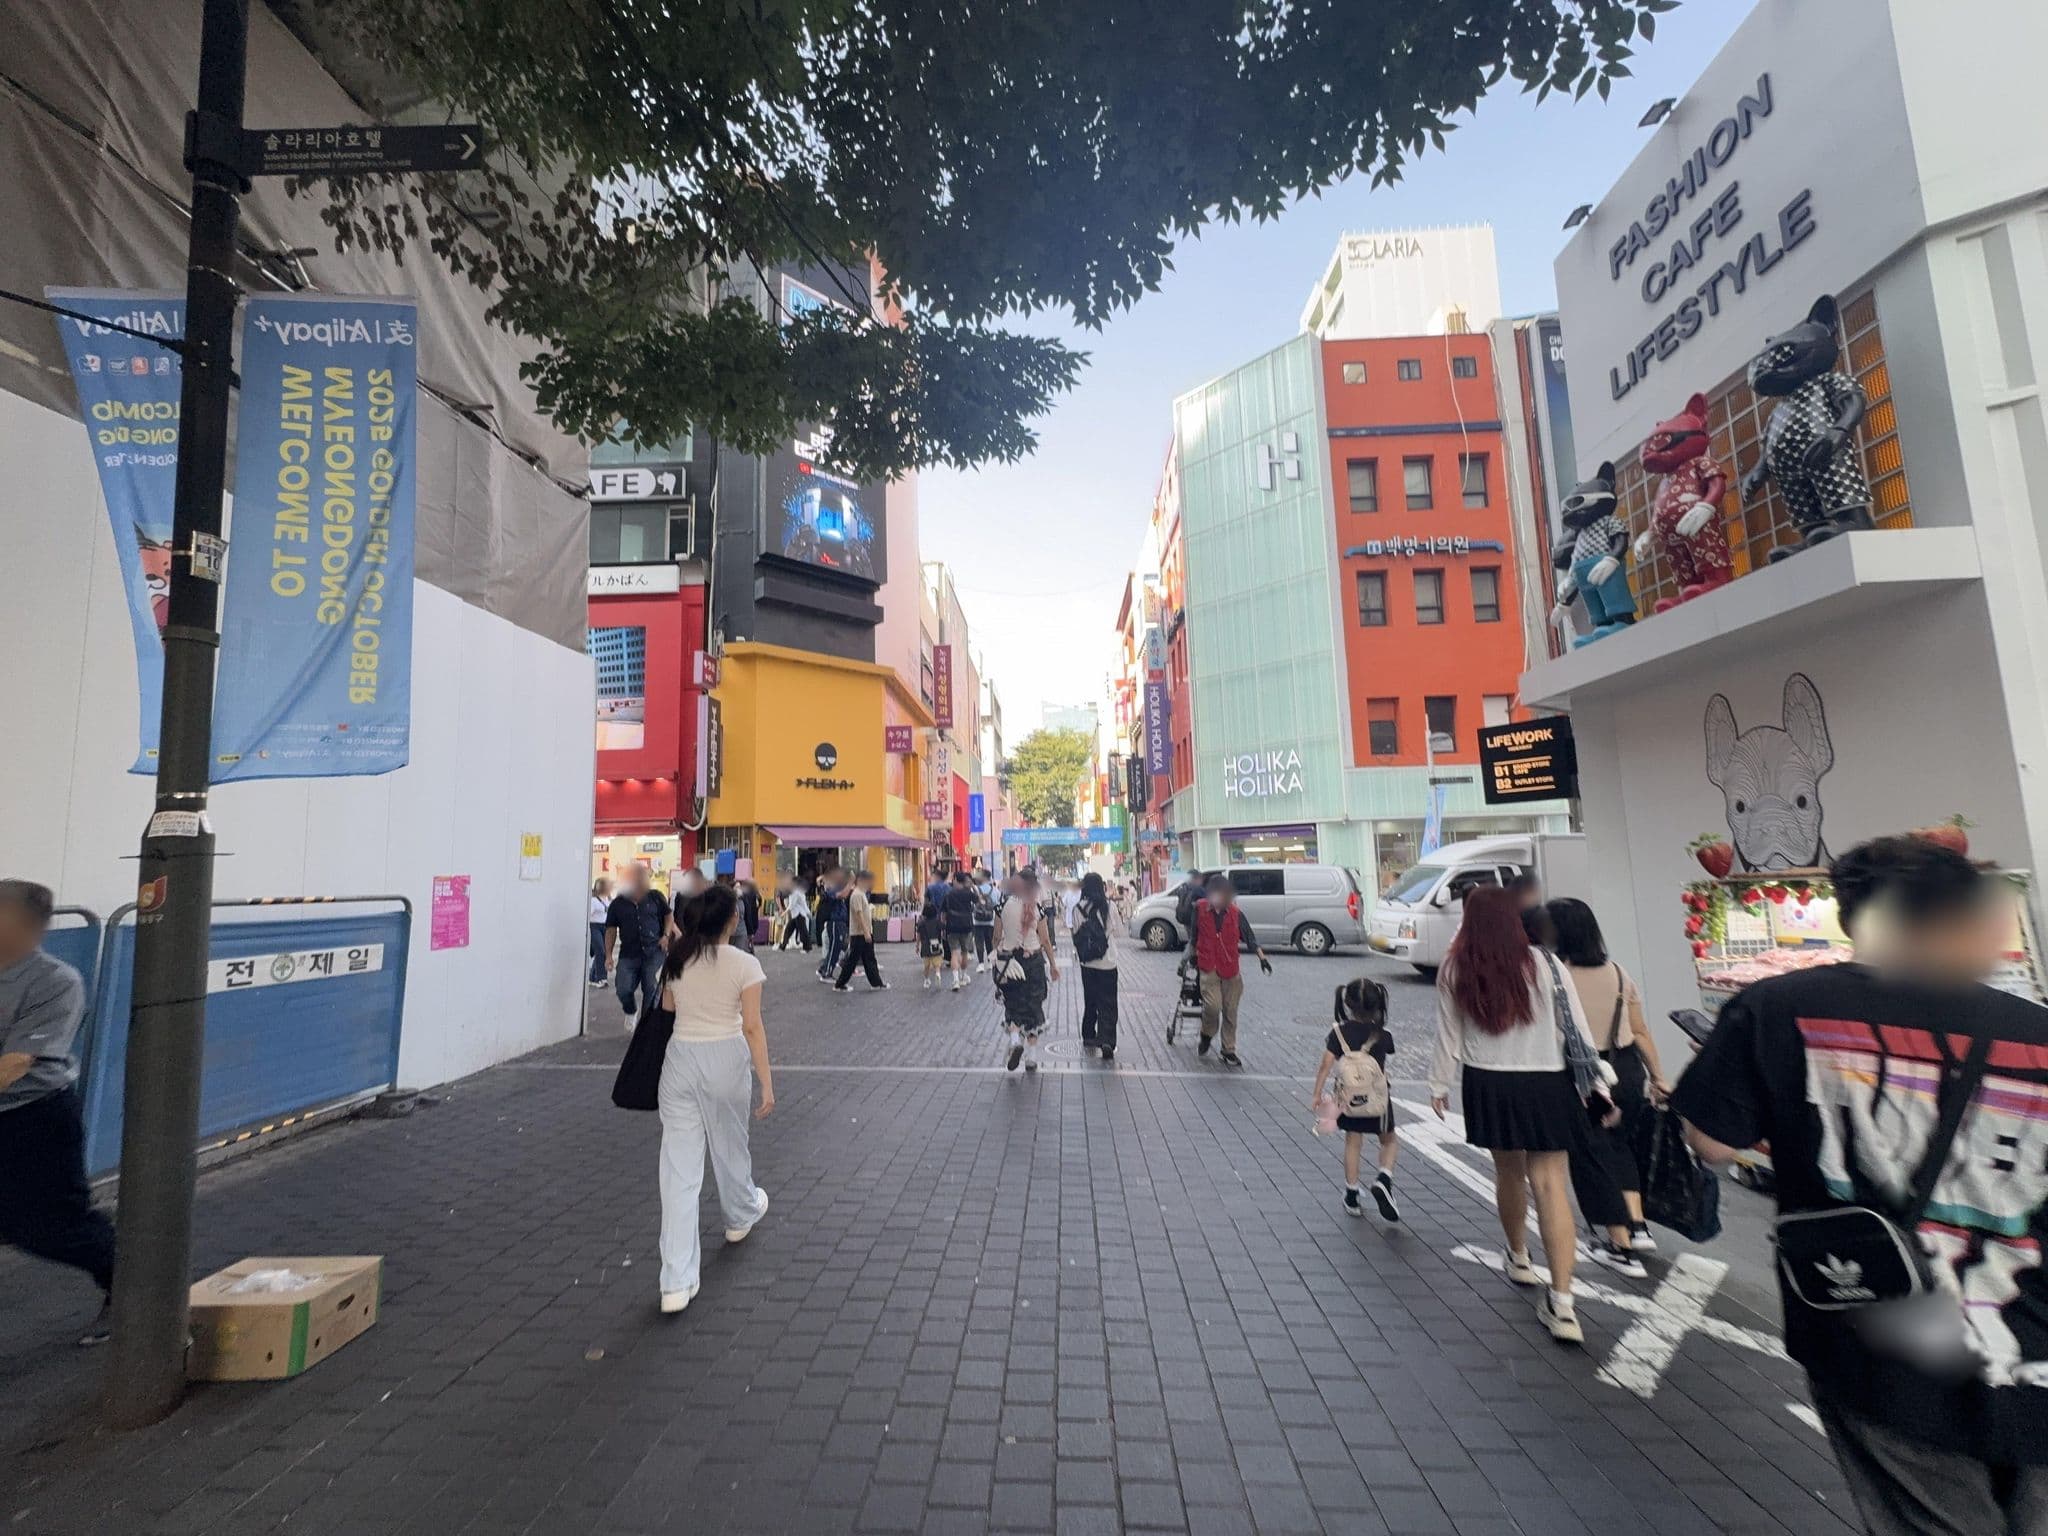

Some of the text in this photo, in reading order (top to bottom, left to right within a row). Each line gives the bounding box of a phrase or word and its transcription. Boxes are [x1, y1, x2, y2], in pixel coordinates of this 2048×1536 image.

[263, 130, 382, 151] 솔라리아호텔
[1609, 72, 1774, 281] FASHION
[1347, 236, 1424, 262] SOLARIA
[1642, 181, 1743, 303] CAFE
[1609, 188, 1817, 401] LIFESTYLE
[1150, 686, 1163, 771] HOLIKA HOLIKA
[1486, 728, 1553, 749] LIFEWORK
[1224, 749, 1303, 778] HOLIKA
[1494, 765, 1510, 778] B1
[1225, 773, 1304, 799] HOLIKA
[1495, 777, 1513, 790] B2
